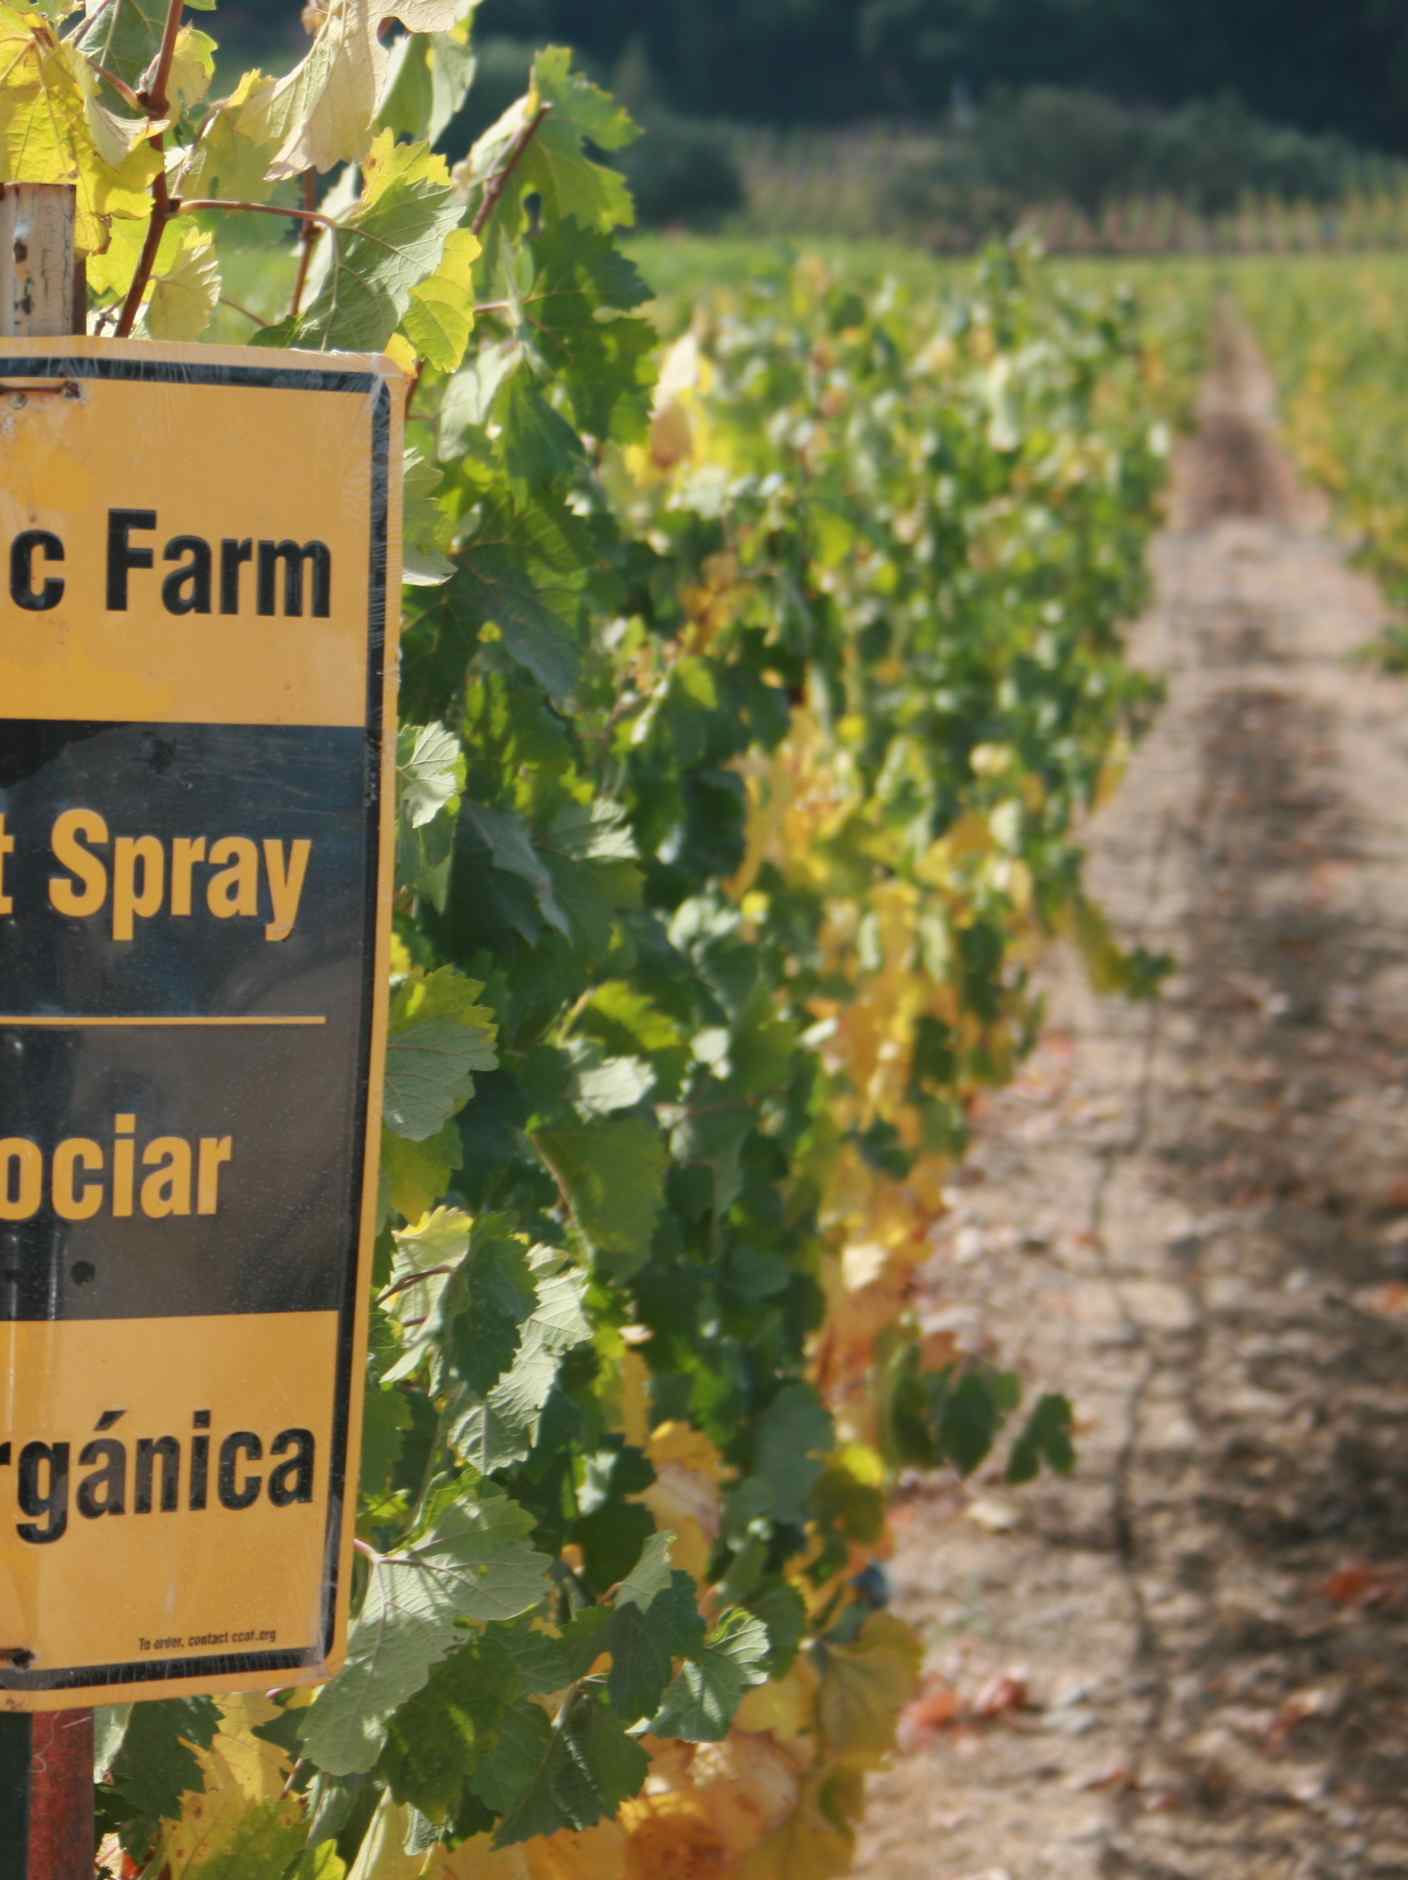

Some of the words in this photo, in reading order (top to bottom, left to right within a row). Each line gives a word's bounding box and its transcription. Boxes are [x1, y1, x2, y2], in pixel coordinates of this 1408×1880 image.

[107, 508, 332, 618] Farm
[48, 808, 312, 942] Spray
[139, 1637, 150, 1650] To
[188, 1632, 228, 1646] contact
